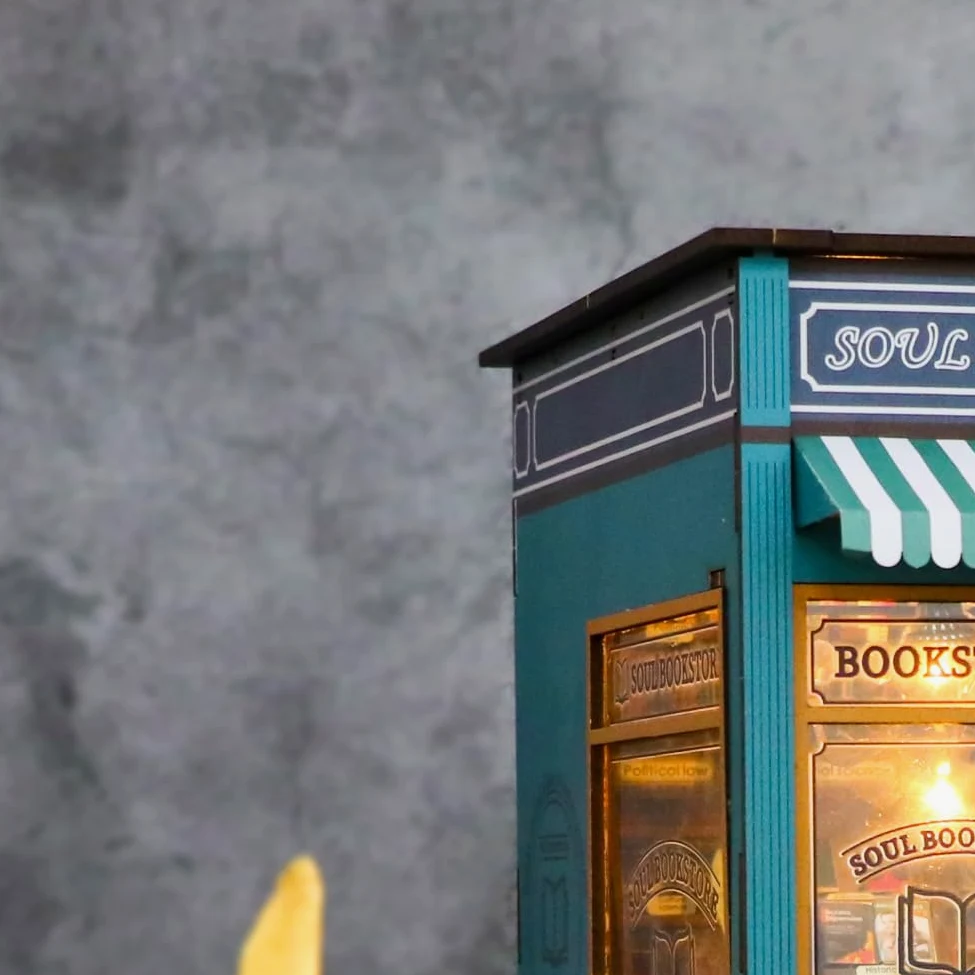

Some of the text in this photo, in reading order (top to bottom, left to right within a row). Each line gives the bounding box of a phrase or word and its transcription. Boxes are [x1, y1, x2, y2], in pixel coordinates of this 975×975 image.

[825, 322, 969, 371] SOUL
[659, 648, 719, 688] BOOKSTOR
[849, 836, 917, 877] SOUL
